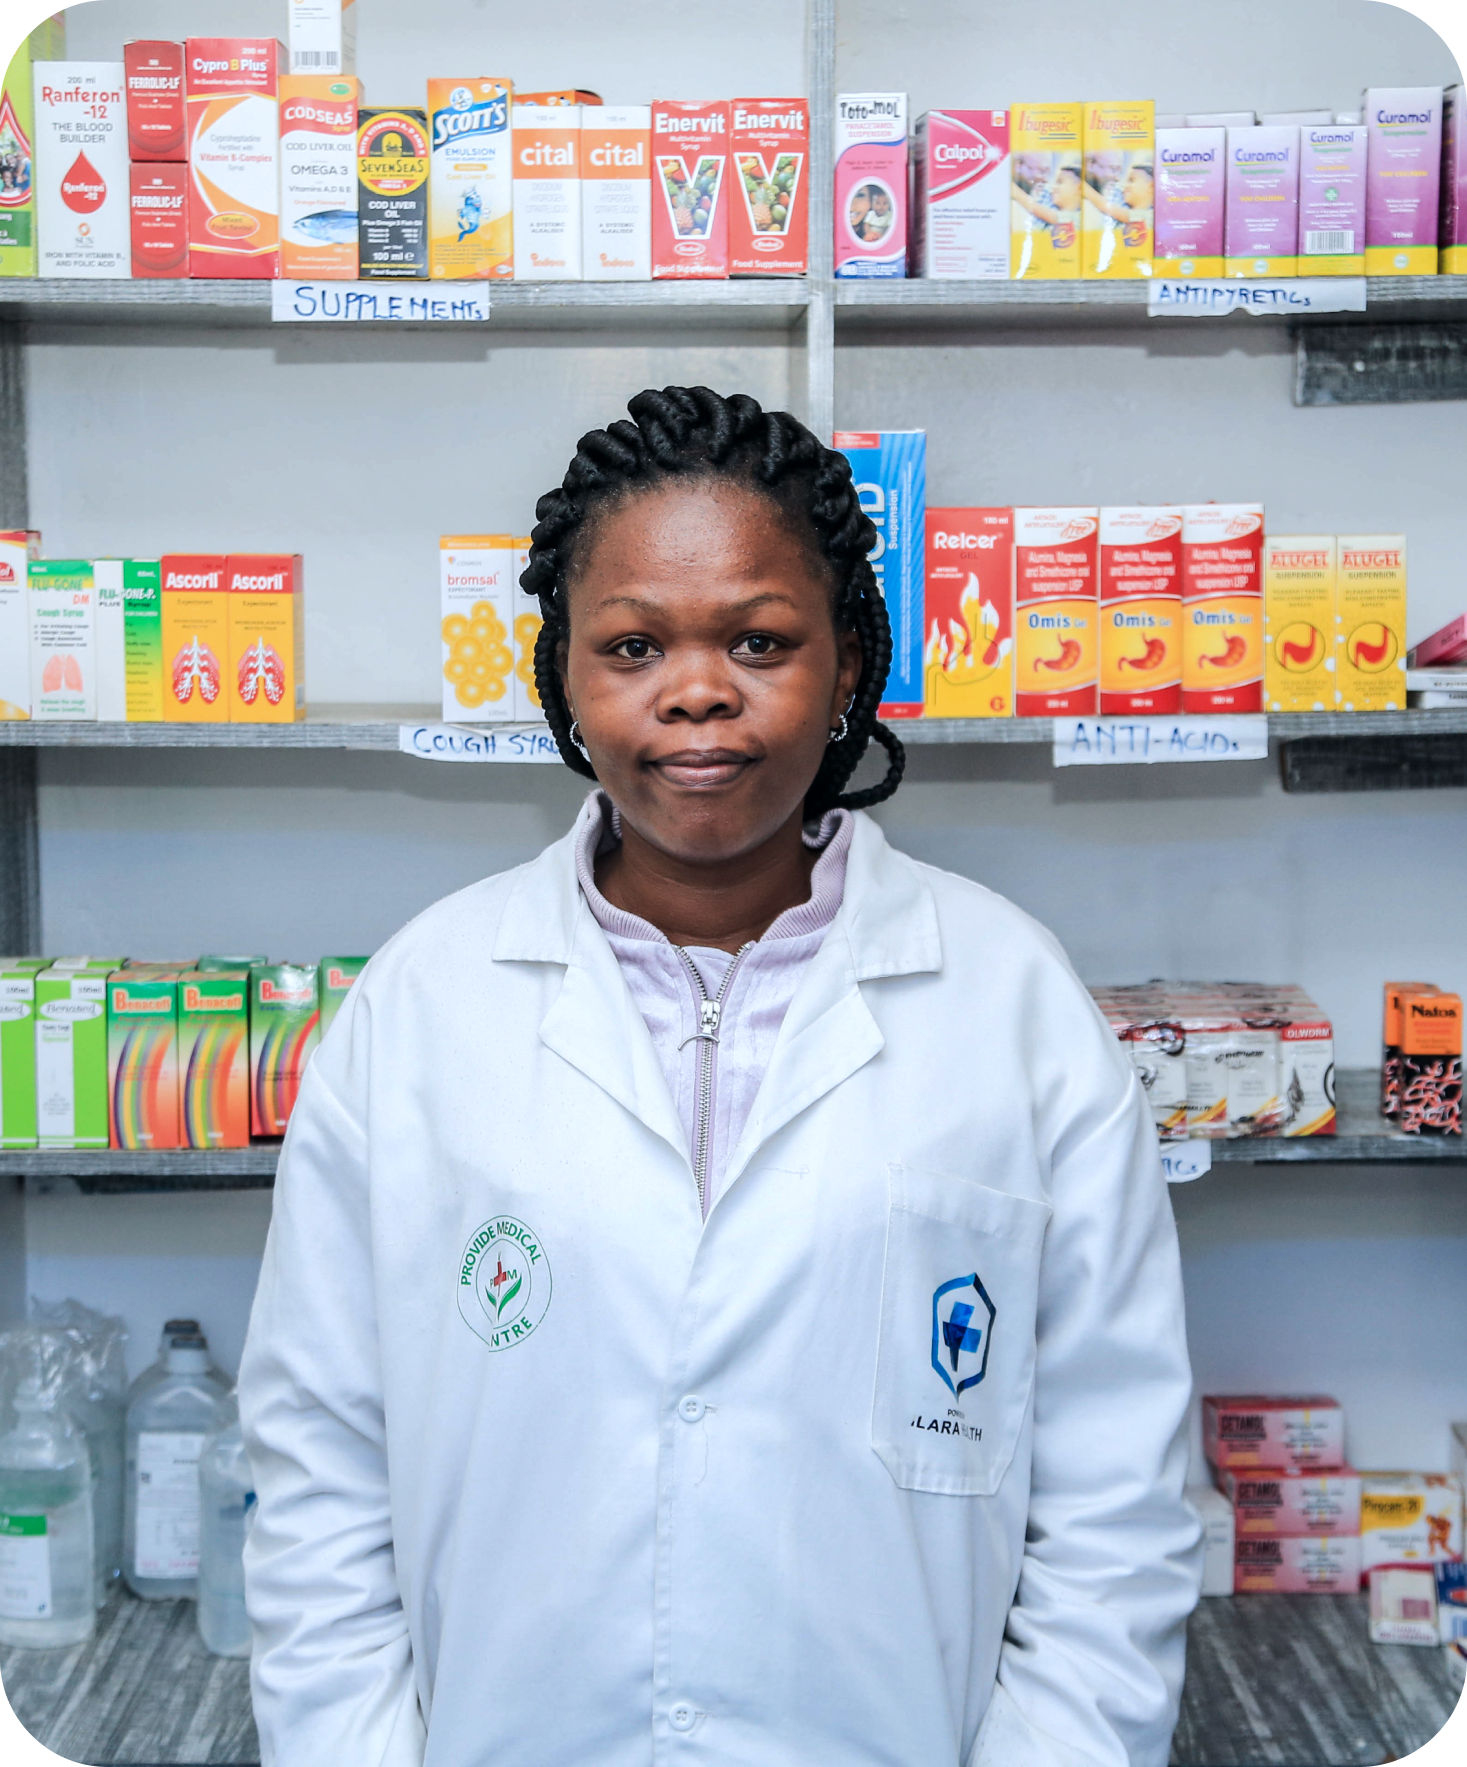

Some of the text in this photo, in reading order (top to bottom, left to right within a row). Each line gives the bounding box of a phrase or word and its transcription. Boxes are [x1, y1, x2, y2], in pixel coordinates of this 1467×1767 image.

[192, 57, 267, 75] Cypro B Plus
[42, 86, 120, 107] Ranferon
[83, 104, 108, 119] -12
[285, 106, 354, 126] CODSEAS
[1377, 109, 1432, 125] Curamol
[434, 101, 507, 147] SCOTT'S
[655, 112, 726, 135] Enervit
[733, 108, 805, 131] Enervit
[845, 122, 896, 131] PARACETAMOL
[1017, 110, 1074, 136] Ibugesic
[1089, 109, 1145, 135] Ibugesic
[52, 122, 114, 132] THE BLOOD
[332, 125, 352, 134] Syrup
[60, 133, 106, 143] BUILDER
[669, 135, 712, 143] Multivitamin
[748, 131, 791, 140] Multivitamin
[847, 130, 893, 139] SUSPENSION
[1310, 131, 1355, 144] Curamol
[286, 142, 354, 152] COD LIVER OIL
[359, 135, 371, 156] WITH
[680, 142, 701, 152] Syrup
[758, 138, 780, 149] Syrup
[445, 147, 496, 157] EMULSION
[520, 141, 574, 167] cital
[589, 141, 644, 167] cital
[934, 143, 985, 165] Calpol
[1161, 148, 1216, 163] Curamol
[1235, 147, 1290, 162] Curamol
[200, 153, 273, 166] Vitamin B-Complex
[290, 164, 349, 176] OMEGA 3
[63, 182, 105, 194] Ranferon
[288, 184, 322, 193] Vitamins
[368, 201, 417, 211] COD LIVER
[384, 209, 401, 219] OIL
[373, 251, 404, 262] 100 ml
[74, 260, 95, 268] FOLIC
[98, 260, 115, 268] ACID
[655, 264, 676, 274] Food
[732, 259, 804, 271] Food Supplement
[888, 489, 899, 551] Suspension
[934, 531, 998, 550] Relcer
[960, 552, 979, 560] GEL
[1056, 551, 1088, 566] Magnesia
[1270, 551, 1330, 568] ALUGEL
[1342, 551, 1402, 568] ALUGEL
[1078, 565, 1091, 578] oral
[1276, 571, 1325, 580] SUSPENSION
[1348, 571, 1397, 580] SUSPENSION
[32, 578, 84, 592] FLU-GONE
[165, 571, 219, 590] Ascoril
[231, 572, 284, 592] Ascoril
[447, 573, 498, 587] bromsal
[72, 594, 91, 606] DM
[37, 608, 85, 619] Cough Syrup
[1113, 612, 1156, 628] Omis
[1192, 610, 1236, 626] Omis
[1028, 613, 1071, 629] Omis
[413, 730, 496, 756] COUGH
[1411, 1004, 1457, 1019] Natoa
[1287, 1029, 1331, 1040] OLWORM
[460, 1221, 542, 1287] PROVIDE MEDICAL
